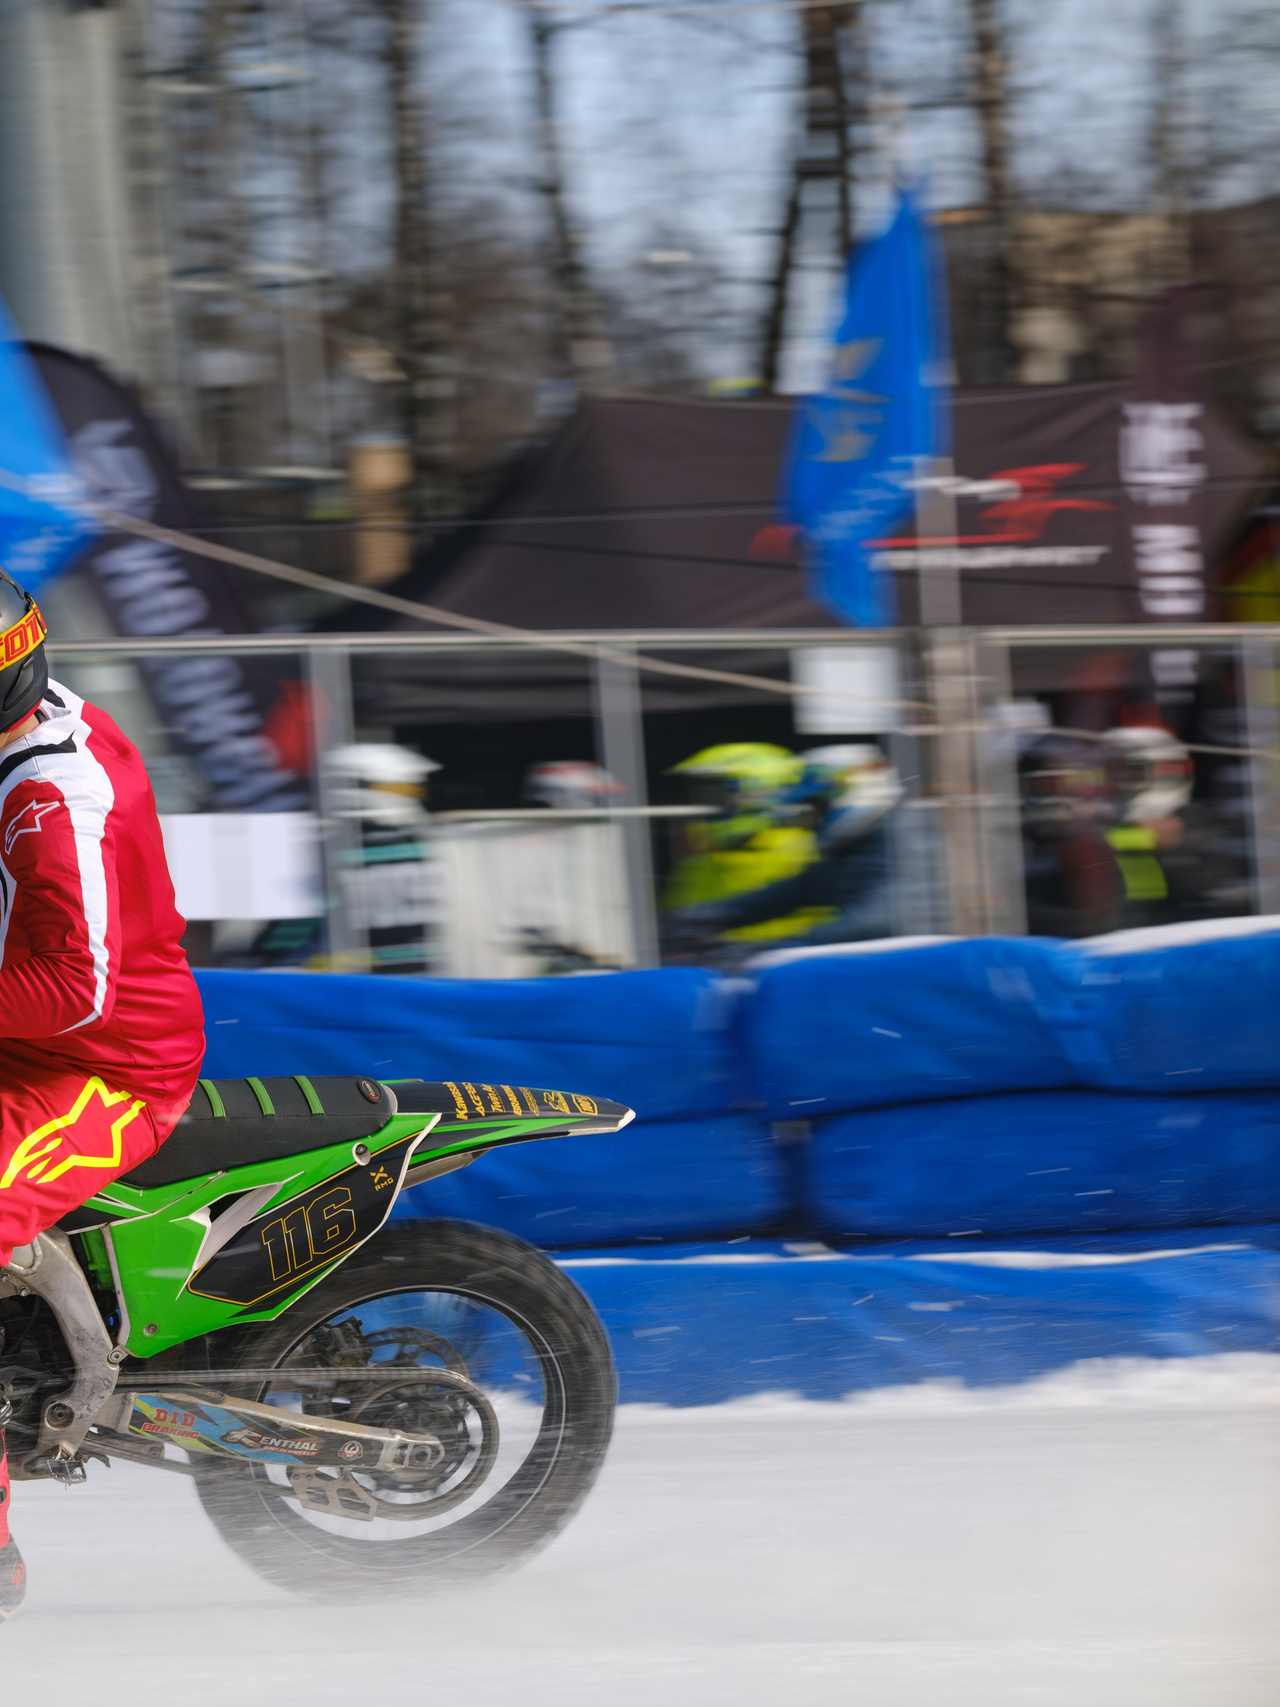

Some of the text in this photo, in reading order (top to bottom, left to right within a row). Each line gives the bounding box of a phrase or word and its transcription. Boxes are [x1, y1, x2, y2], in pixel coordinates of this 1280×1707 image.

[374, 1177, 394, 1192] RMG
[261, 1187, 356, 1281] 116
[141, 1422, 200, 1440] BRAKING
